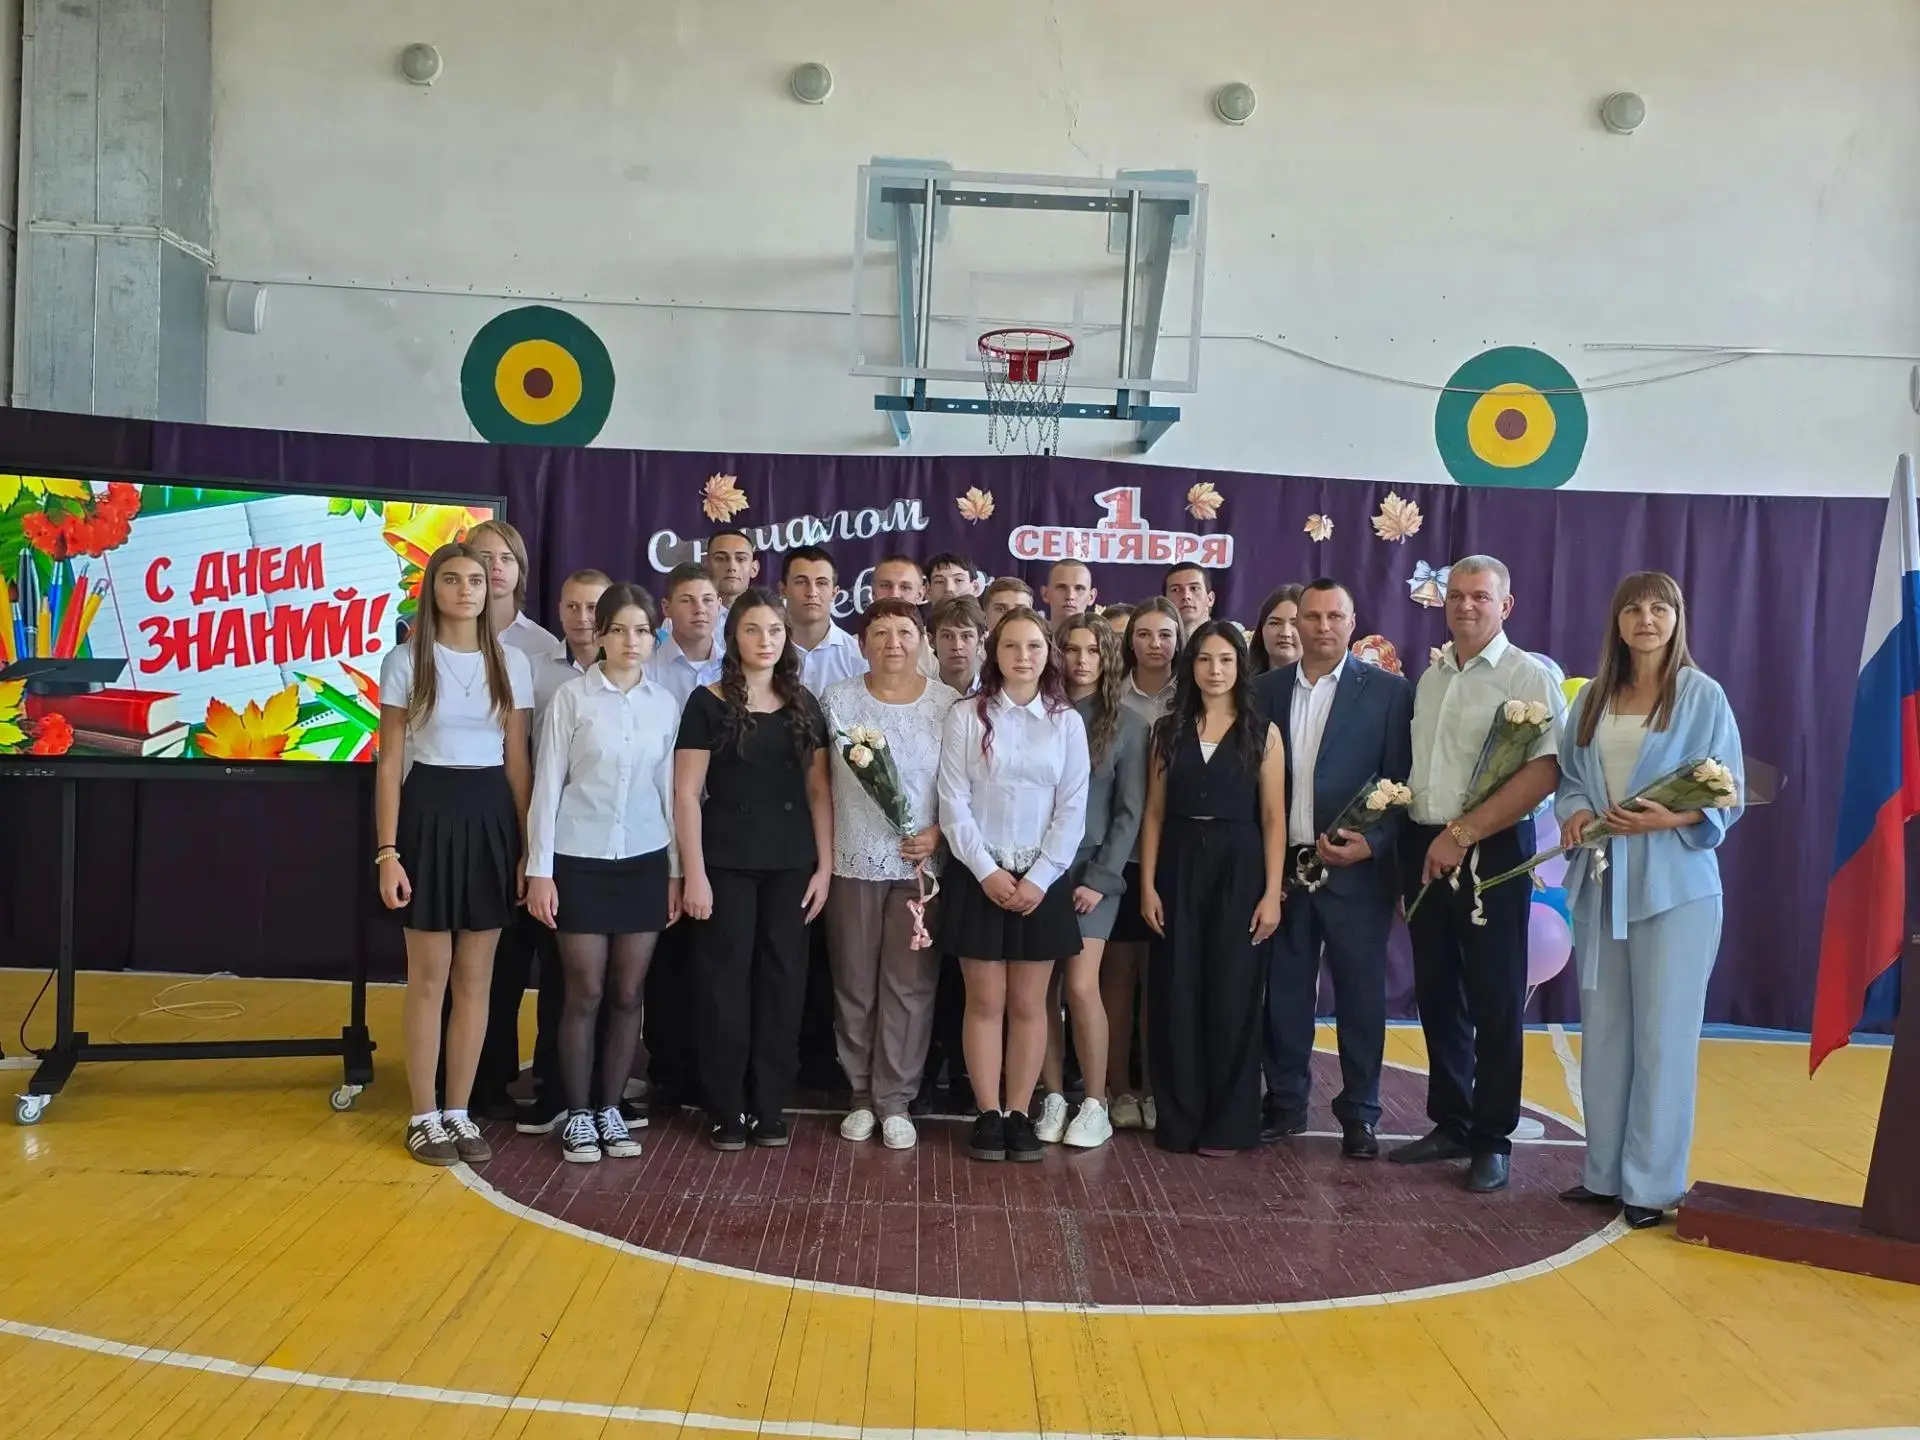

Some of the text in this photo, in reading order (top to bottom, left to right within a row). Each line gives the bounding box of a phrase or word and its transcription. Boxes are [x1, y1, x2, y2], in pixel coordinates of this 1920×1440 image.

[647, 498, 929, 574] С чалом
[1101, 489, 1142, 530] 1
[145, 542, 325, 606] С ДНЕМ
[1014, 528, 1228, 564] СЕНТЯБРЯ
[138, 586, 392, 674] ЗНАНИЙ!
